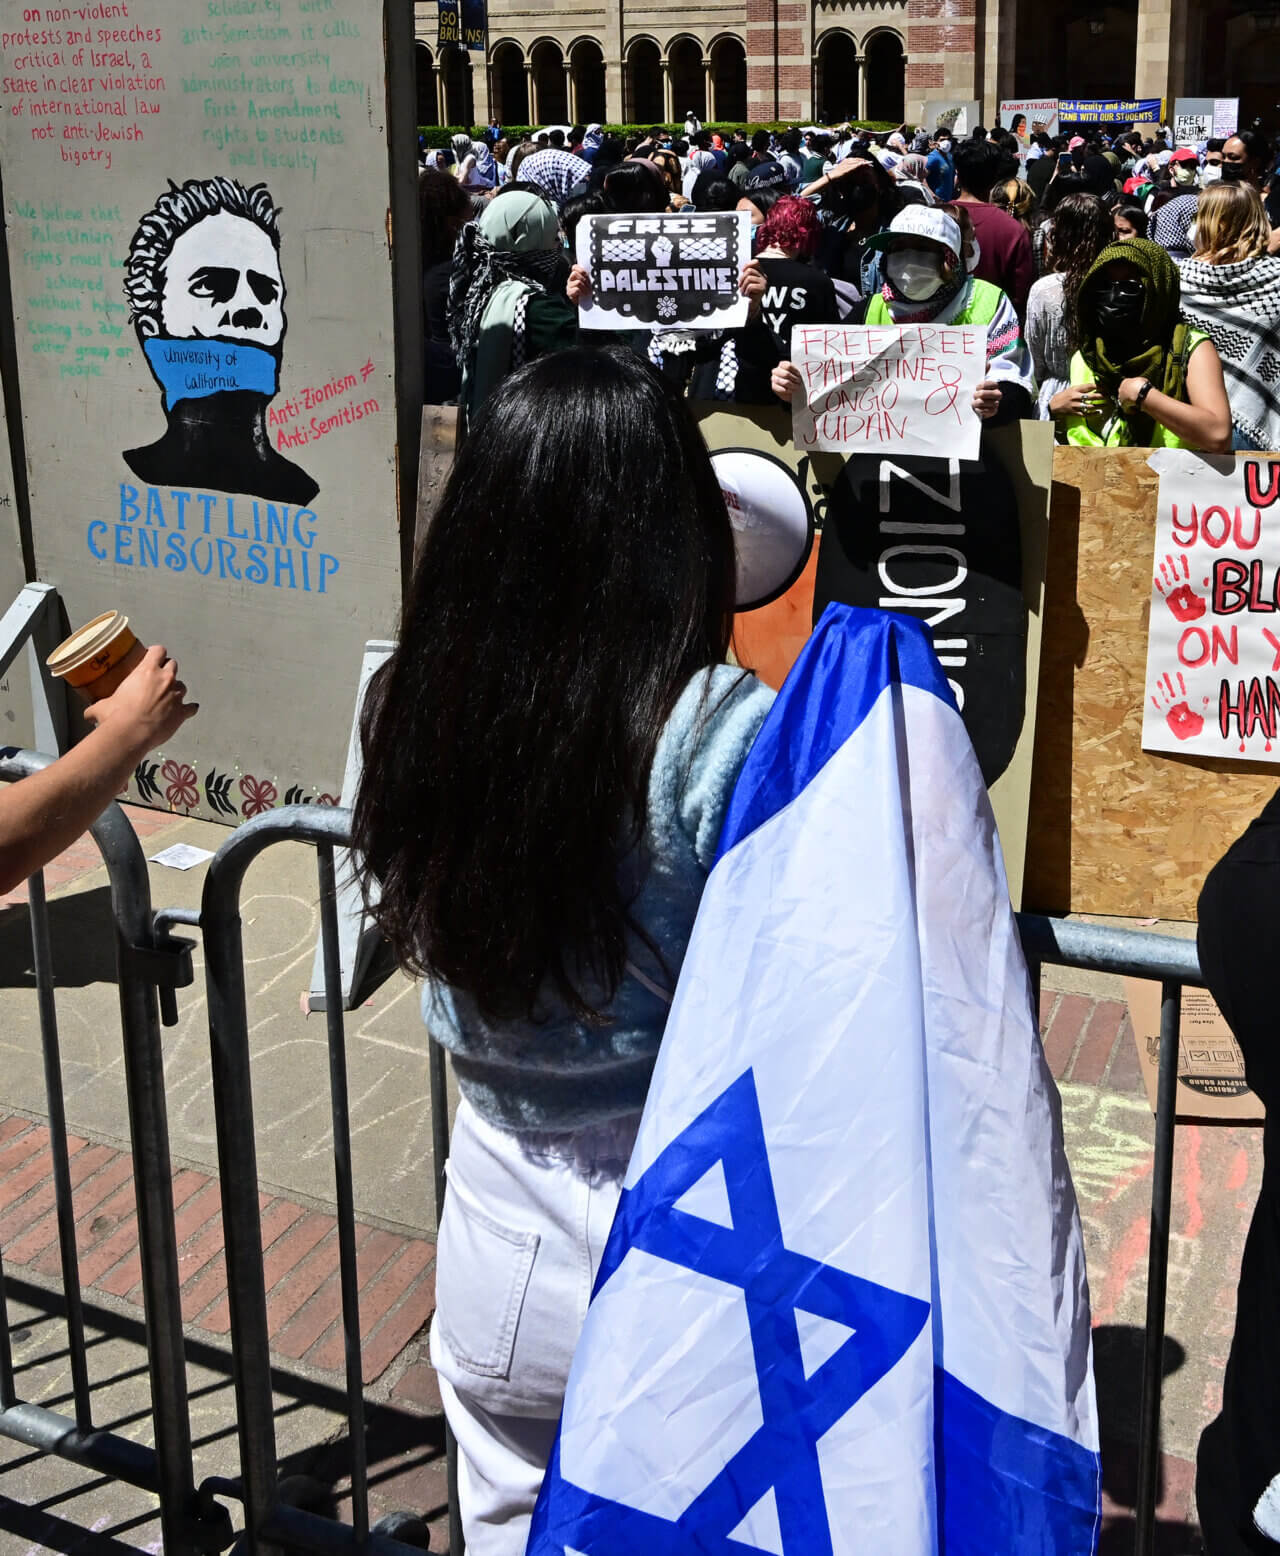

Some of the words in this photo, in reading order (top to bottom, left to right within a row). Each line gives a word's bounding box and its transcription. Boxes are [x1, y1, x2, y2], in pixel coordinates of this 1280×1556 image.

[23, 9, 41, 22] on
[46, 2, 128, 23] non-violent
[440, 11, 456, 26] GO
[2, 28, 62, 50] protests
[66, 26, 92, 46] and
[97, 24, 162, 48] speeches
[14, 51, 66, 70] critical
[72, 48, 85, 67] of
[91, 48, 135, 70] Israel,
[142, 52, 152, 68] a
[42, 74, 57, 92] in
[60, 76, 94, 93] clear
[100, 73, 165, 92] violation
[12, 98, 23, 116] of
[29, 96, 128, 117] international
[135, 96, 161, 115] law
[248, 96, 342, 120] Amendment
[1080, 112, 1098, 121] WITH
[1100, 111, 1114, 121] OUR
[1116, 111, 1153, 121] STUDENTS
[31, 122, 55, 141] not
[60, 144, 112, 169] bigotry
[608, 219, 717, 235] FREE
[601, 268, 732, 294] PALESTINE
[800, 327, 886, 356] FREE
[889, 326, 976, 355] FREE
[163, 350, 221, 371] University
[225, 348, 238, 365] of
[184, 374, 240, 390] California
[802, 357, 937, 388] PALESTINE
[268, 375, 358, 427] Anti-Zionism
[807, 382, 899, 414] CONGO
[277, 397, 379, 451] Anti-Semitism
[803, 410, 908, 445] SUDAN
[119, 482, 318, 549] BATTLING
[1171, 502, 1262, 550] YOU
[87, 520, 340, 593] CENSORSHIP
[1177, 624, 1239, 669] ON
